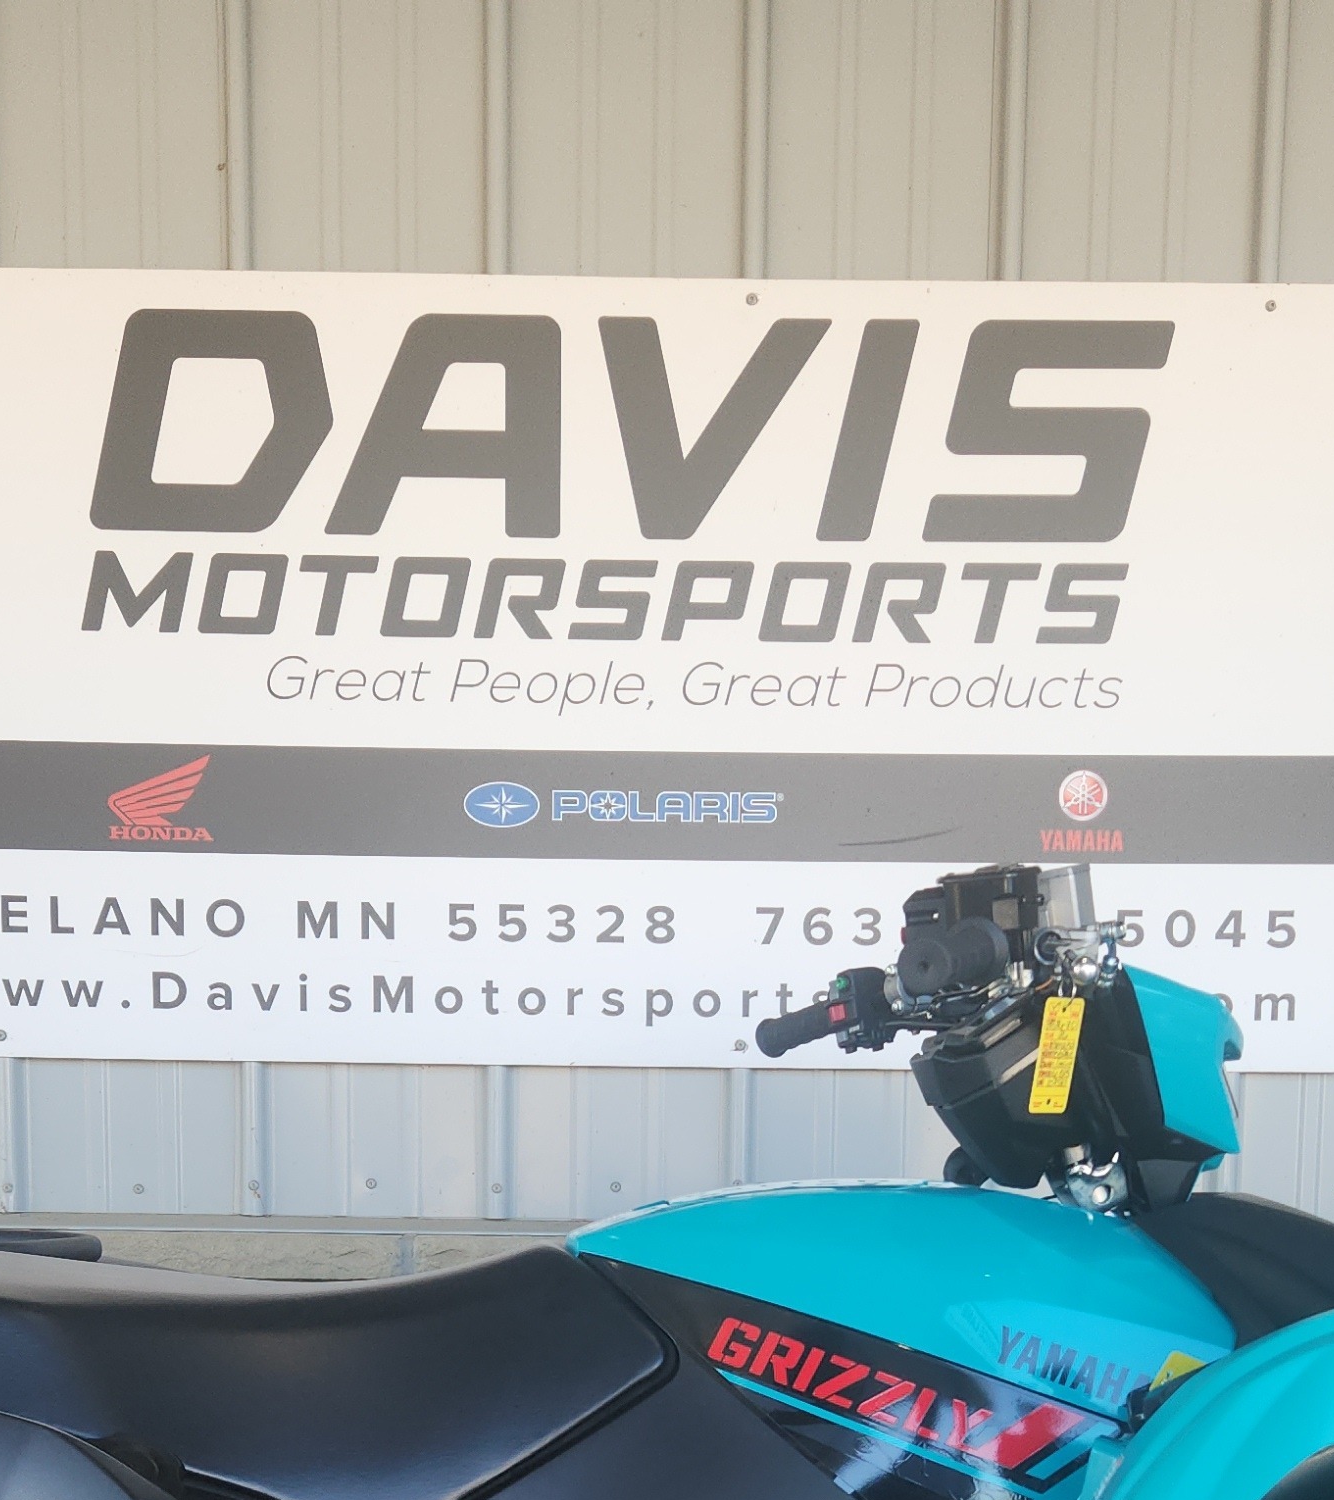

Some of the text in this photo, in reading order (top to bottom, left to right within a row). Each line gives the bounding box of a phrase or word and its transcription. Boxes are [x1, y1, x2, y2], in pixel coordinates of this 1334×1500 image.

[89, 308, 1176, 543] DAVIS
[81, 550, 1129, 644] MOTORSPORTS
[267, 655, 1123, 716] Great People, Great Products
[108, 824, 214, 842] HONDA
[551, 789, 778, 824] POLARIS
[1039, 829, 1124, 853] YAMAHA
[297, 900, 397, 941] MN
[448, 904, 677, 945] 55328
[755, 906, 883, 947] 763
[1116, 909, 1297, 950] 5045
[707, 1317, 994, 1451] GRIZZLY
